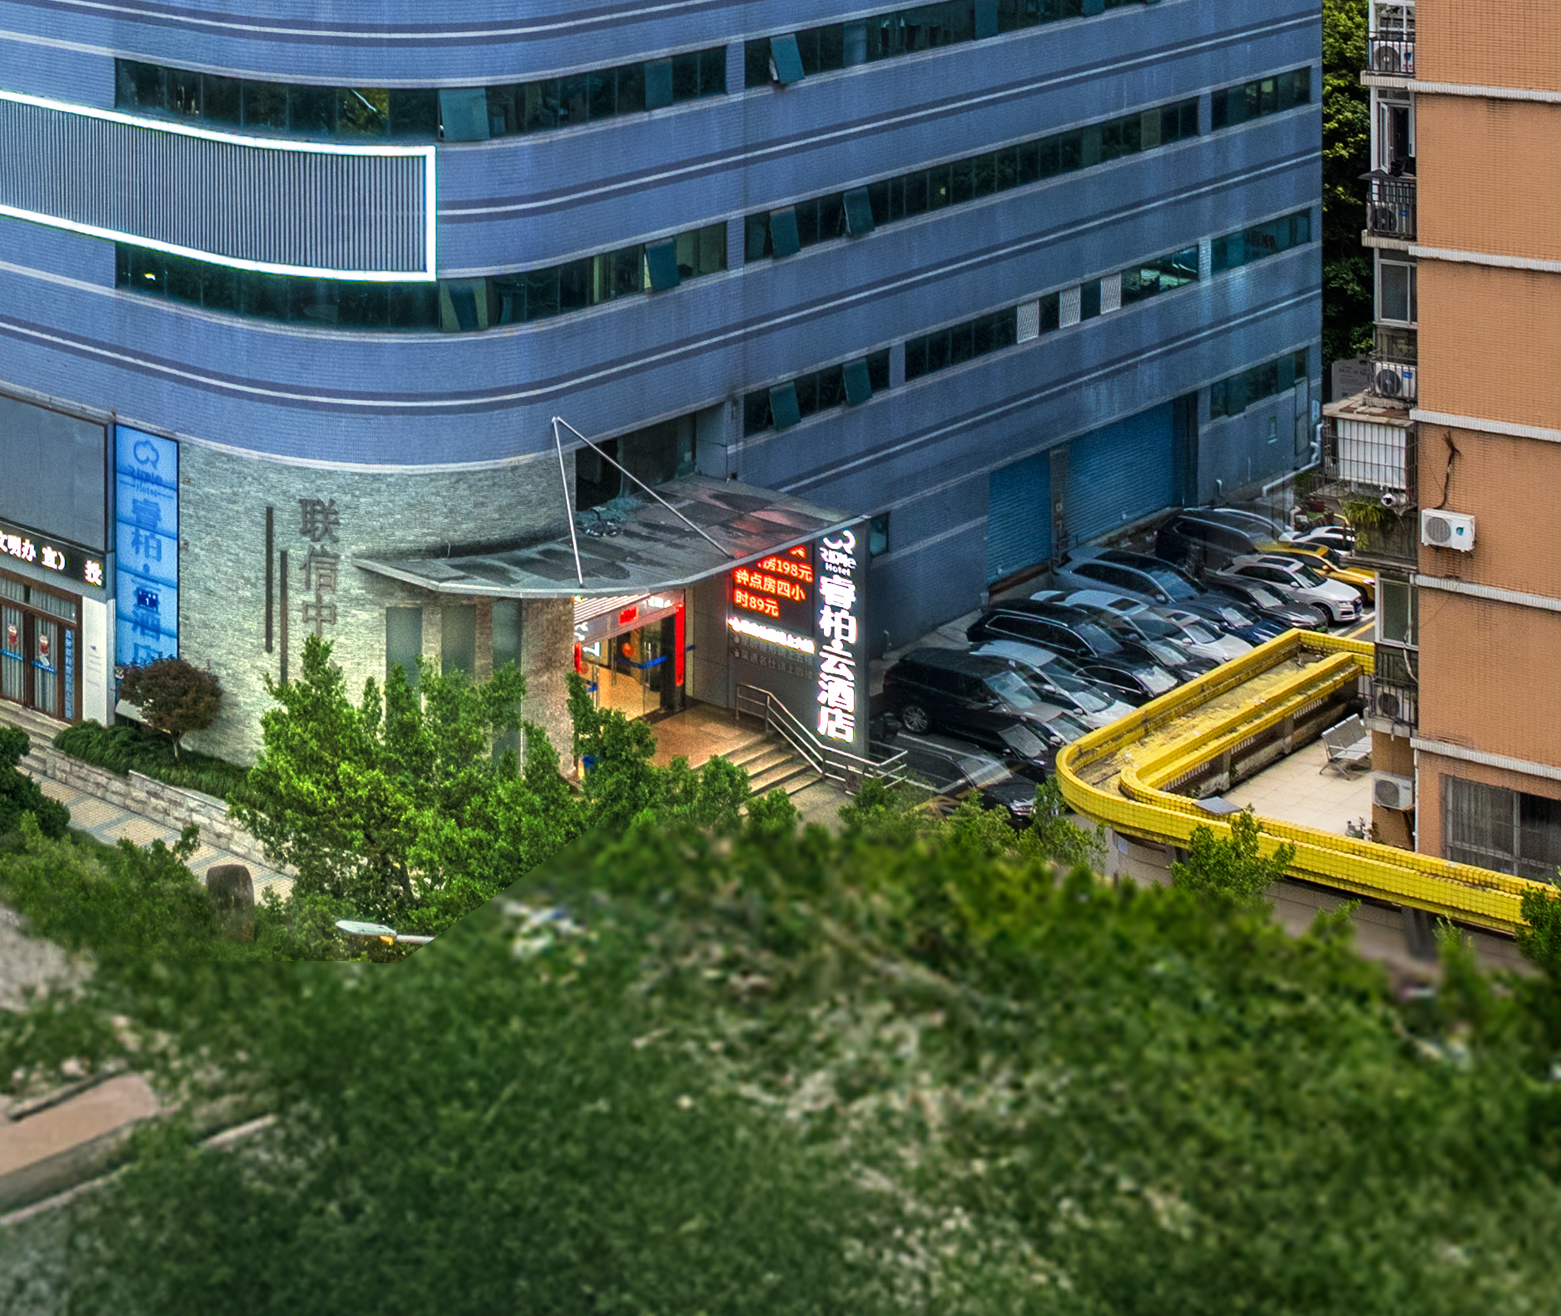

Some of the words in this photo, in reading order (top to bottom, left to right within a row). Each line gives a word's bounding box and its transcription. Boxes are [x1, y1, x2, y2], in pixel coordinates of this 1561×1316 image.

[299, 498, 341, 672] 联信中
[734, 568, 807, 602] 钟点房四小
[757, 555, 814, 584] 房198元
[734, 588, 780, 618] 时89元
